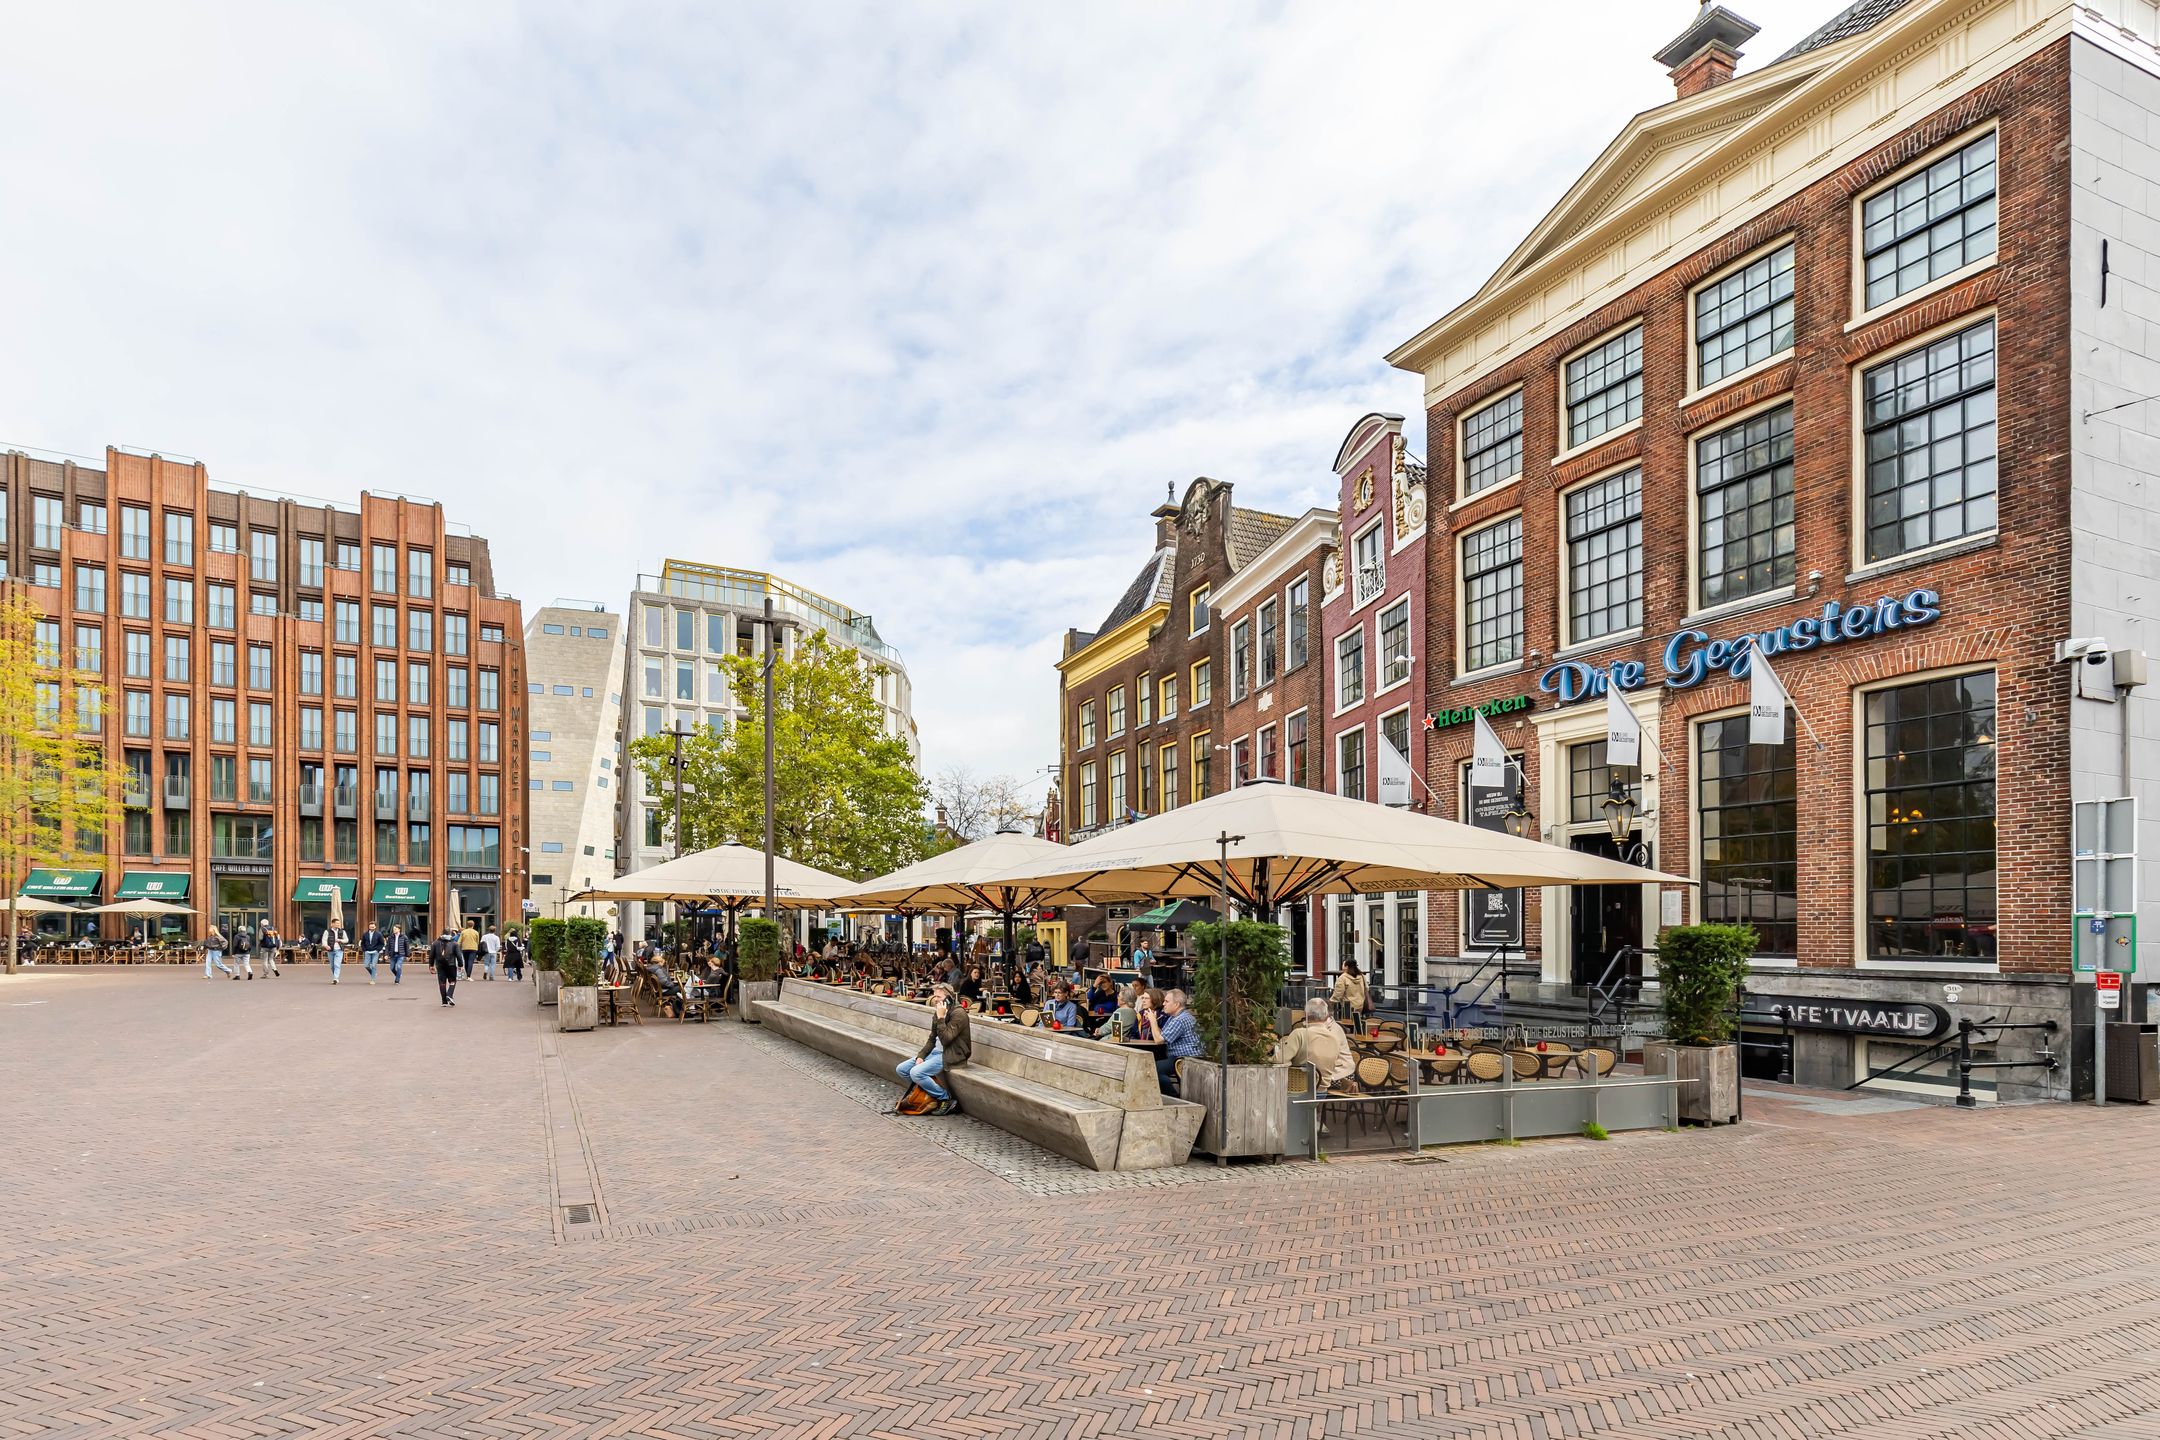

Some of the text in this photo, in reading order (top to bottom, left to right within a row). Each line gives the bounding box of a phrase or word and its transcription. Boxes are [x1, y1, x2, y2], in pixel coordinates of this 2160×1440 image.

[1539, 589, 1941, 701] Drie Gezusters
[511, 706, 520, 801] MARKET
[511, 814, 520, 894] HOTEL
[1542, 1025, 1585, 1039] GEZUSTERS
[1843, 1009, 1929, 1031] VAATJE
